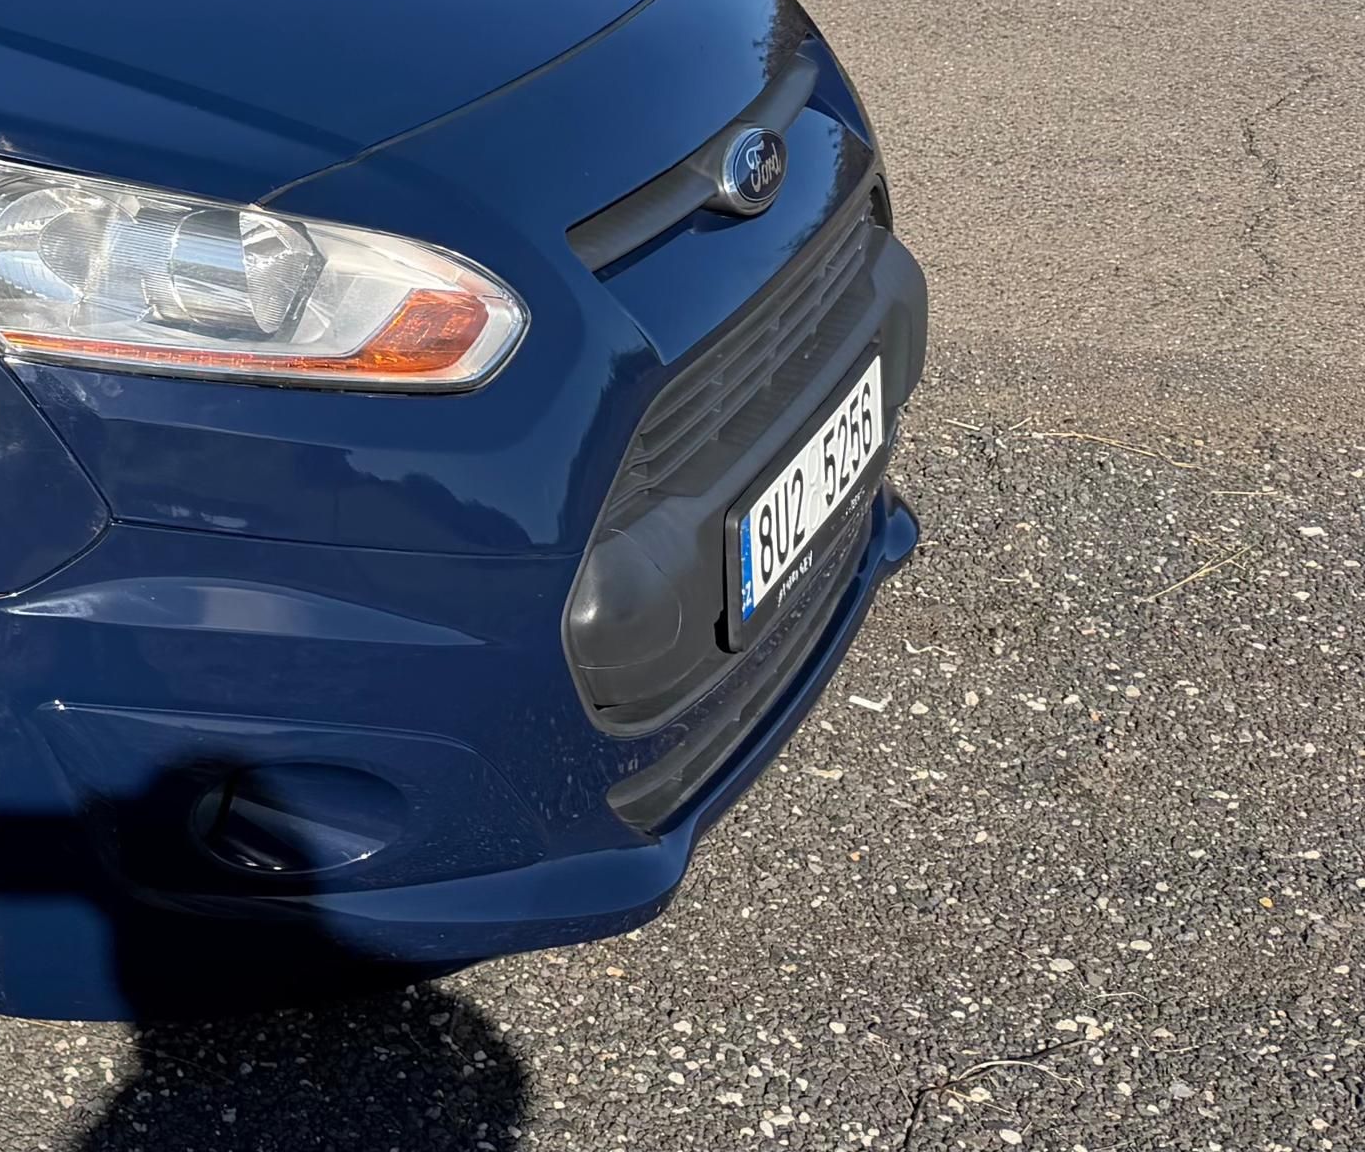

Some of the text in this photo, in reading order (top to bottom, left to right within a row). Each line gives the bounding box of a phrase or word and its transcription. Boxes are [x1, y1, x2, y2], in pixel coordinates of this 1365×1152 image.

[746, 140, 782, 193] Ford
[759, 468, 805, 585] 8U2
[823, 382, 872, 506] 5256
